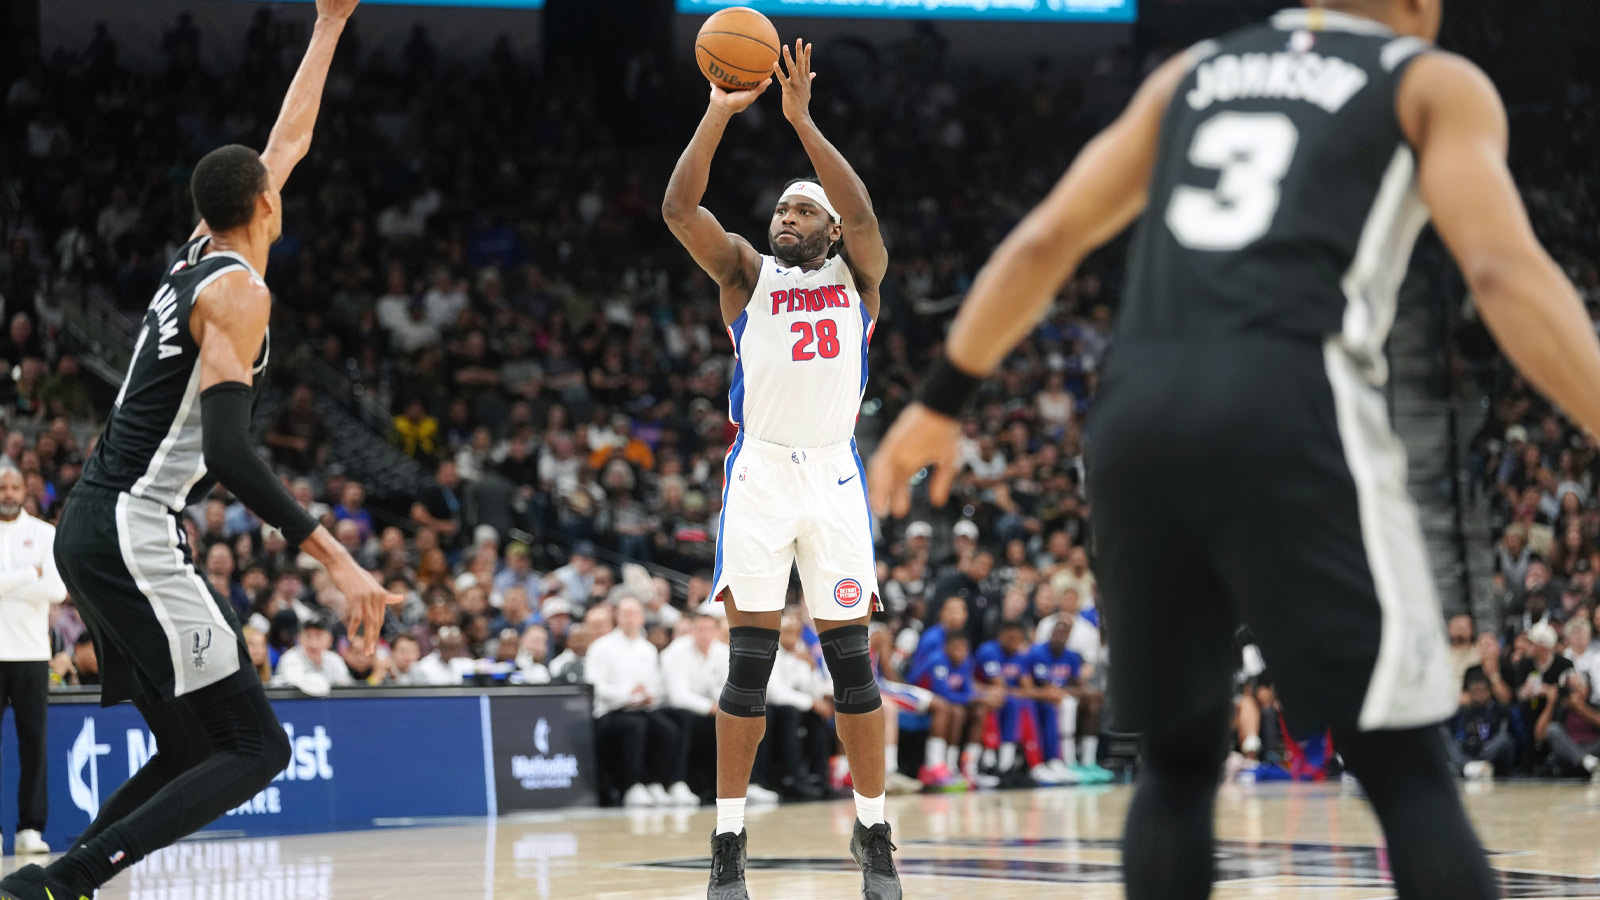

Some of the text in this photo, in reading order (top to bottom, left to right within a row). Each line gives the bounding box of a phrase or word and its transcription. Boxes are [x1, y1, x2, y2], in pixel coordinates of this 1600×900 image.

[708, 60, 761, 88] Wilson
[1186, 51, 1367, 113] JOHNSON
[1165, 110, 1299, 250] 3
[770, 284, 850, 316] PISTONS
[790, 318, 841, 362] 28
